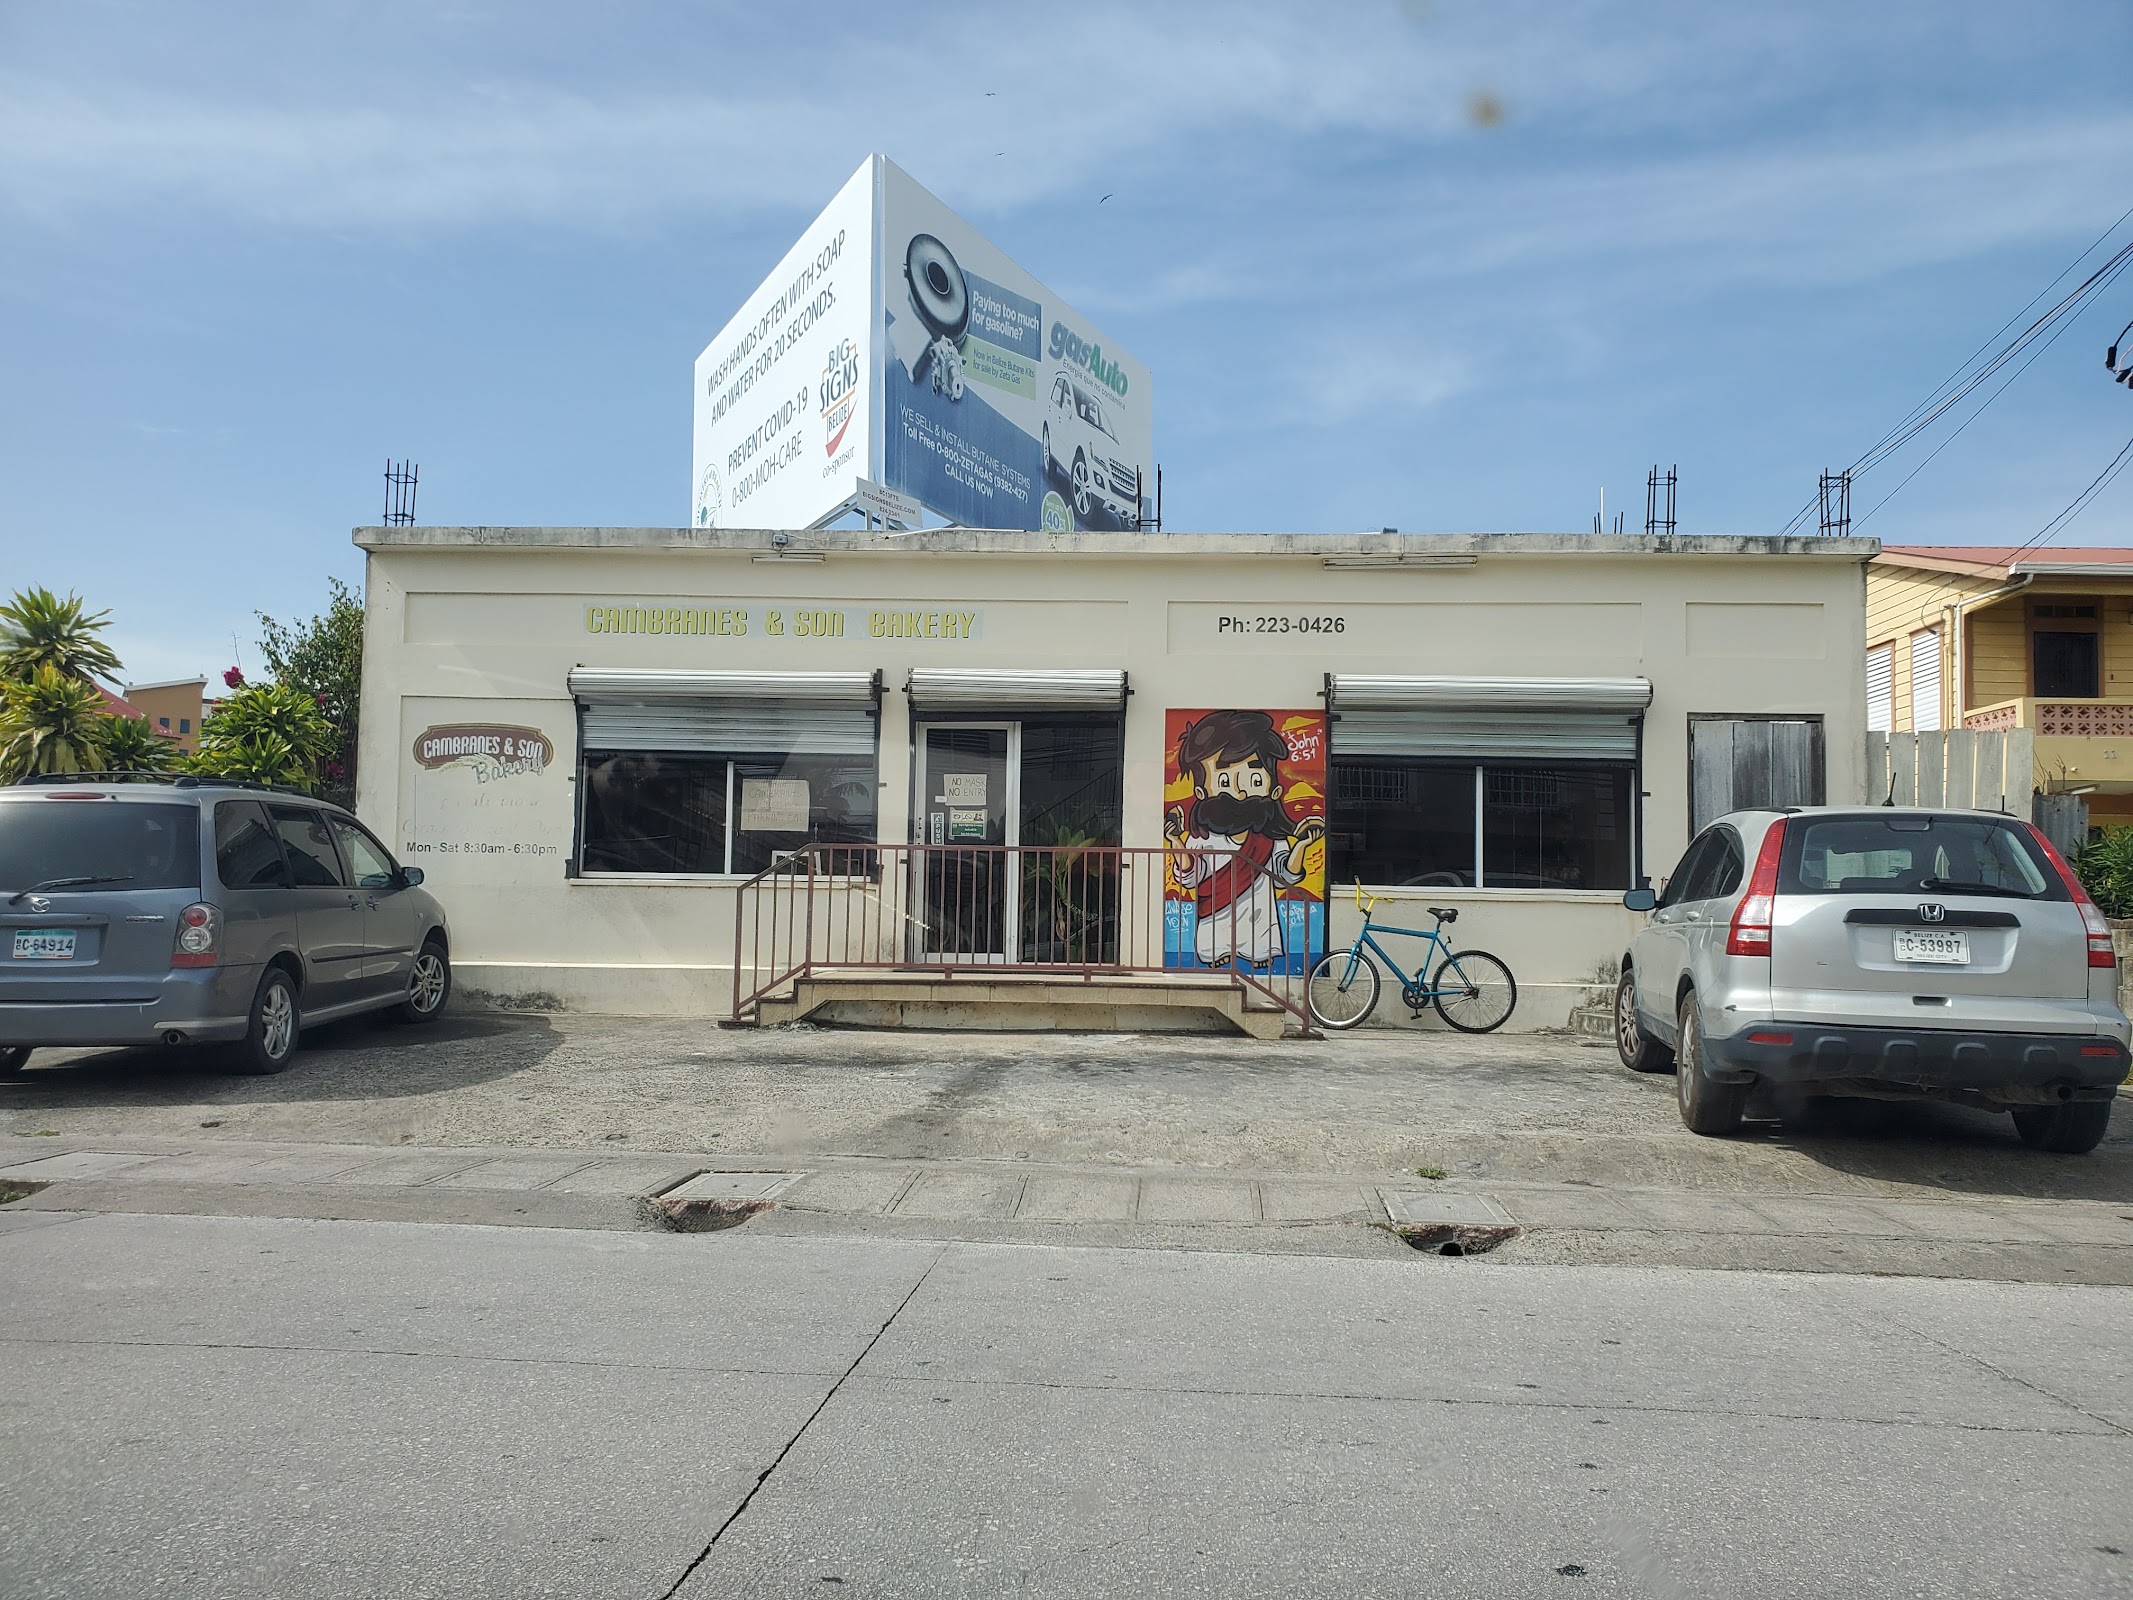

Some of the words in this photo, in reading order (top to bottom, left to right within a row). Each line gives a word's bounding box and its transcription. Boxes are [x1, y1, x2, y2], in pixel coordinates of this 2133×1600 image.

[707, 357, 729, 396] WASH
[730, 326, 757, 374] HANDS
[759, 291, 788, 341] OFTEN
[789, 262, 814, 309] WITH
[816, 229, 845, 280] SOAP
[972, 308, 984, 326] for
[985, 316, 1024, 341] gasoline?
[973, 291, 1001, 318] Paying
[1002, 304, 1016, 321] too
[1017, 312, 1040, 331] much
[711, 400, 727, 428] AND
[728, 366, 754, 411] WATER
[755, 346, 773, 382] FOR
[774, 334, 785, 364] 20
[787, 281, 837, 350] SECONDS.
[828, 337, 850, 374] BIG
[973, 347, 986, 359] Now
[986, 352, 992, 362] in
[992, 353, 1007, 369] Belize
[1007, 361, 1025, 375] Butane
[1025, 365, 1035, 378] Kits
[1047, 320, 1128, 397] gasAuto
[820, 353, 859, 414] SIGNS
[972, 360, 981, 370] for
[981, 363, 991, 375] sale
[991, 366, 999, 378] by
[999, 370, 1011, 381] Zeta
[1011, 373, 1021, 384] Gas
[1083, 375, 1094, 387] que
[1094, 382, 1101, 392] no
[728, 425, 763, 476] PREVENT
[764, 386, 808, 442] COVID-19
[828, 403, 848, 432] BELIZE
[822, 446, 856, 479] co-sponsor
[900, 403, 914, 422] WE
[915, 412, 934, 433] SELL
[934, 424, 941, 437] &
[941, 427, 971, 456] INSTALL
[971, 445, 1000, 472] BUTANE
[1001, 463, 1031, 490] SYSTEMS
[903, 421, 918, 440] Toll
[919, 430, 936, 451] Free
[936, 441, 994, 484] 0-800-ZETAGAS
[993, 475, 1029, 504] (9382-427)
[731, 430, 803, 508] 0-800-MOH-CARE
[944, 463, 964, 484] CALL
[964, 473, 975, 489] US
[975, 481, 994, 499] NOW
[585, 606, 748, 637] CAMBRANES
[764, 609, 785, 637] &
[793, 610, 845, 638] SON
[868, 610, 977, 640] BAKERY
[1218, 616, 1250, 633] Ph:
[1255, 616, 1345, 633] 223-0426
[423, 735, 501, 759] CAMBRANES
[503, 737, 514, 756] &
[517, 738, 544, 759] SON
[1290, 747, 1316, 762] 6:51
[471, 755, 546, 785] Bakery
[951, 777, 962, 786] NO
[964, 778, 986, 787] MASK
[948, 787, 960, 797] NO
[963, 788, 986, 797] ENTRY
[406, 841, 431, 853] Mon
[439, 842, 459, 853] Sat
[463, 842, 505, 854] 8:30am
[513, 843, 557, 856] 6:30pm
[22, 938, 73, 951] C-64914
[1906, 939, 1961, 954] C-53987
